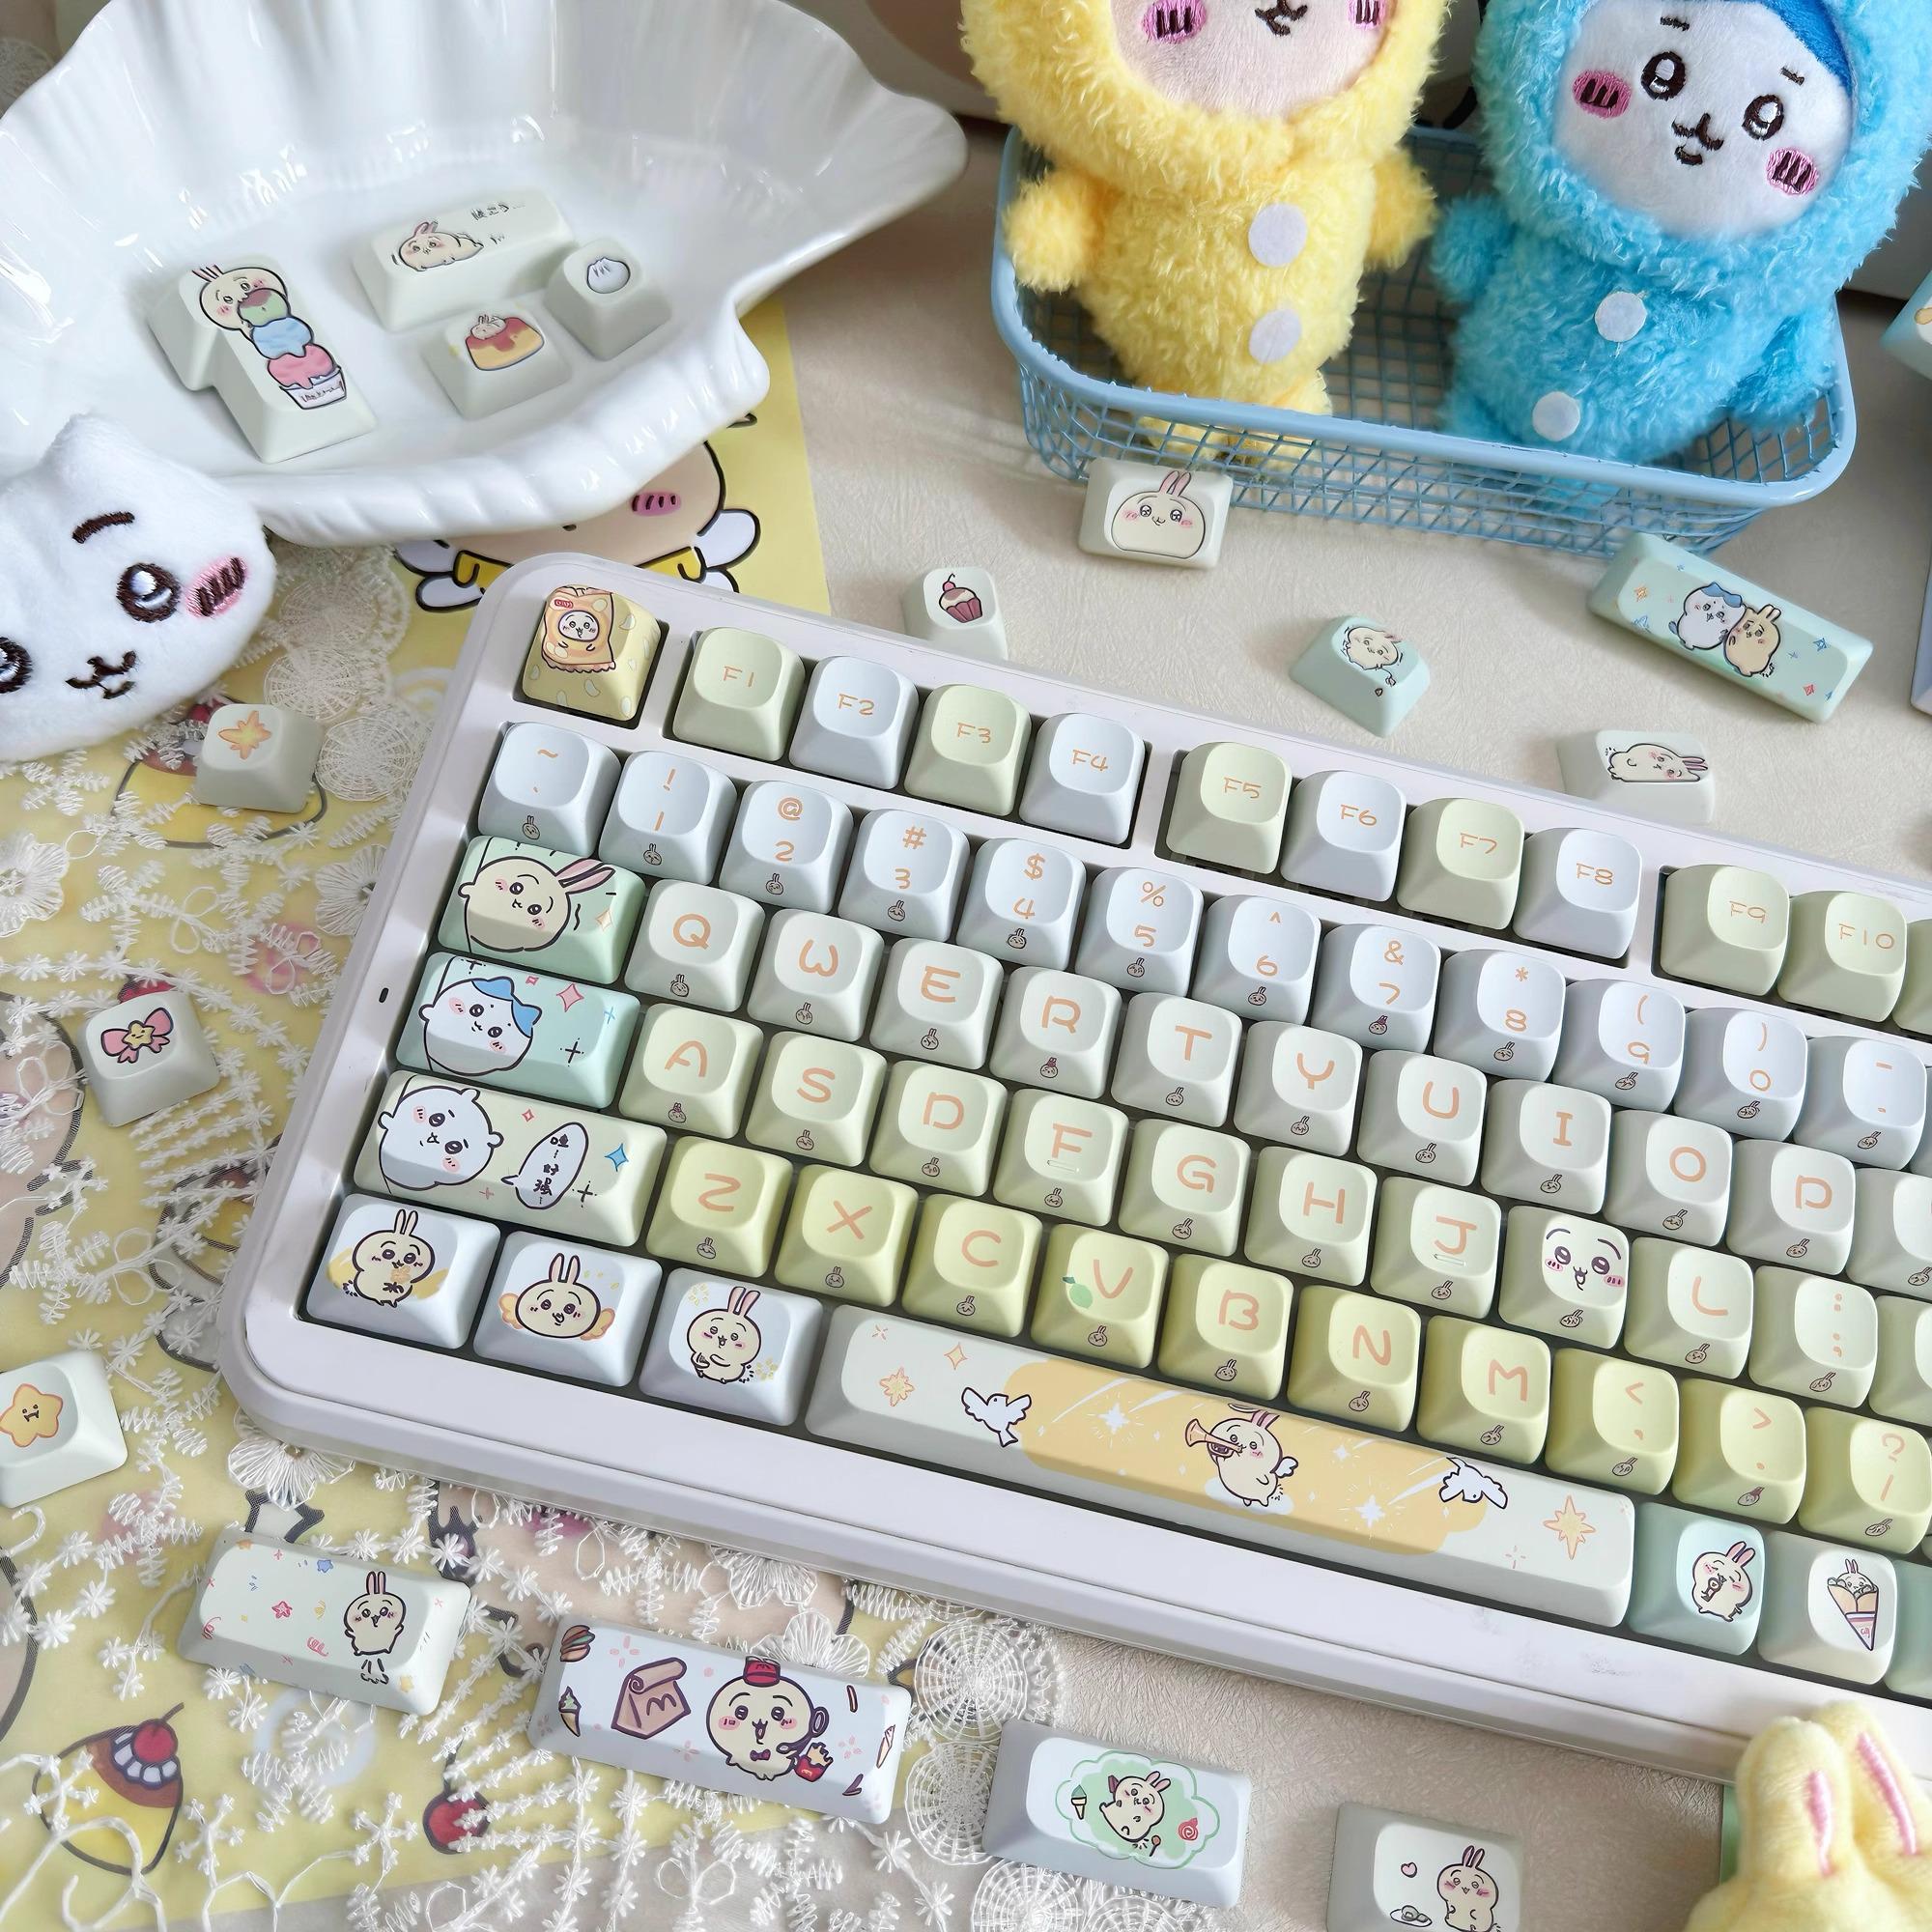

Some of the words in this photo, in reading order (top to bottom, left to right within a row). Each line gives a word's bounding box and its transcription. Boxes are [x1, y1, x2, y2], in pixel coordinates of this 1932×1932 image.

[723, 665, 753, 687] F1
[837, 693, 875, 717] F2
[957, 723, 990, 743] F3
[1071, 749, 1108, 772] F4
[663, 768, 675, 790] !
[1222, 775, 1262, 800] F5
[778, 796, 803, 822] @
[1341, 804, 1376, 827] F6
[903, 827, 925, 847] #
[1460, 831, 1498, 854] F7
[774, 839, 794, 863] 2
[895, 866, 912, 890] 3
[1025, 854, 1045, 880] $
[1577, 862, 1614, 887] F8
[1012, 896, 1035, 920] 4
[1141, 881, 1165, 908] %
[1270, 912, 1282, 923] ^
[1730, 900, 1769, 923] F9
[672, 913, 711, 948] Q
[1133, 924, 1155, 948] 5
[1839, 921, 1896, 952] F10
[798, 941, 838, 977] W
[1383, 939, 1404, 965] &
[1256, 954, 1278, 978] 6
[921, 966, 959, 1003] E
[1378, 981, 1400, 1005] 7
[1041, 996, 1081, 1033] R
[1505, 1009, 1529, 1033] 8
[1635, 993, 1649, 1024] (
[1175, 1025, 1211, 1061] T
[1758, 1024, 1769, 1051] )
[665, 1040, 707, 1078] A
[1627, 1041, 1650, 1063] 9
[1296, 1052, 1335, 1089] Y
[1748, 1068, 1773, 1094] 0
[798, 1066, 835, 1103] S
[923, 1094, 964, 1129] D
[1422, 1082, 1460, 1119] U
[1051, 1123, 1093, 1157] F
[1552, 1112, 1573, 1148] I
[1177, 1155, 1216, 1191] G
[1669, 1146, 1706, 1182] O
[696, 1174, 742, 1212] Z
[1303, 1182, 1345, 1224] H
[1794, 1176, 1833, 1209] P
[827, 1201, 870, 1240] X
[961, 1230, 1001, 1267] C
[1435, 1215, 1477, 1255] J
[1093, 1260, 1133, 1298] V
[1218, 1291, 1259, 1330] B
[1691, 1277, 1727, 1318] L
[1832, 1291, 1843, 1312] :
[1352, 1324, 1391, 1366] N
[1832, 1333, 1844, 1356] ;
[1488, 1360, 1529, 1403] M
[1625, 1380, 1644, 1406] <
[1751, 1407, 1773, 1430] >
[1881, 1432, 1907, 1462] ?
[1880, 1473, 1893, 1500] /
